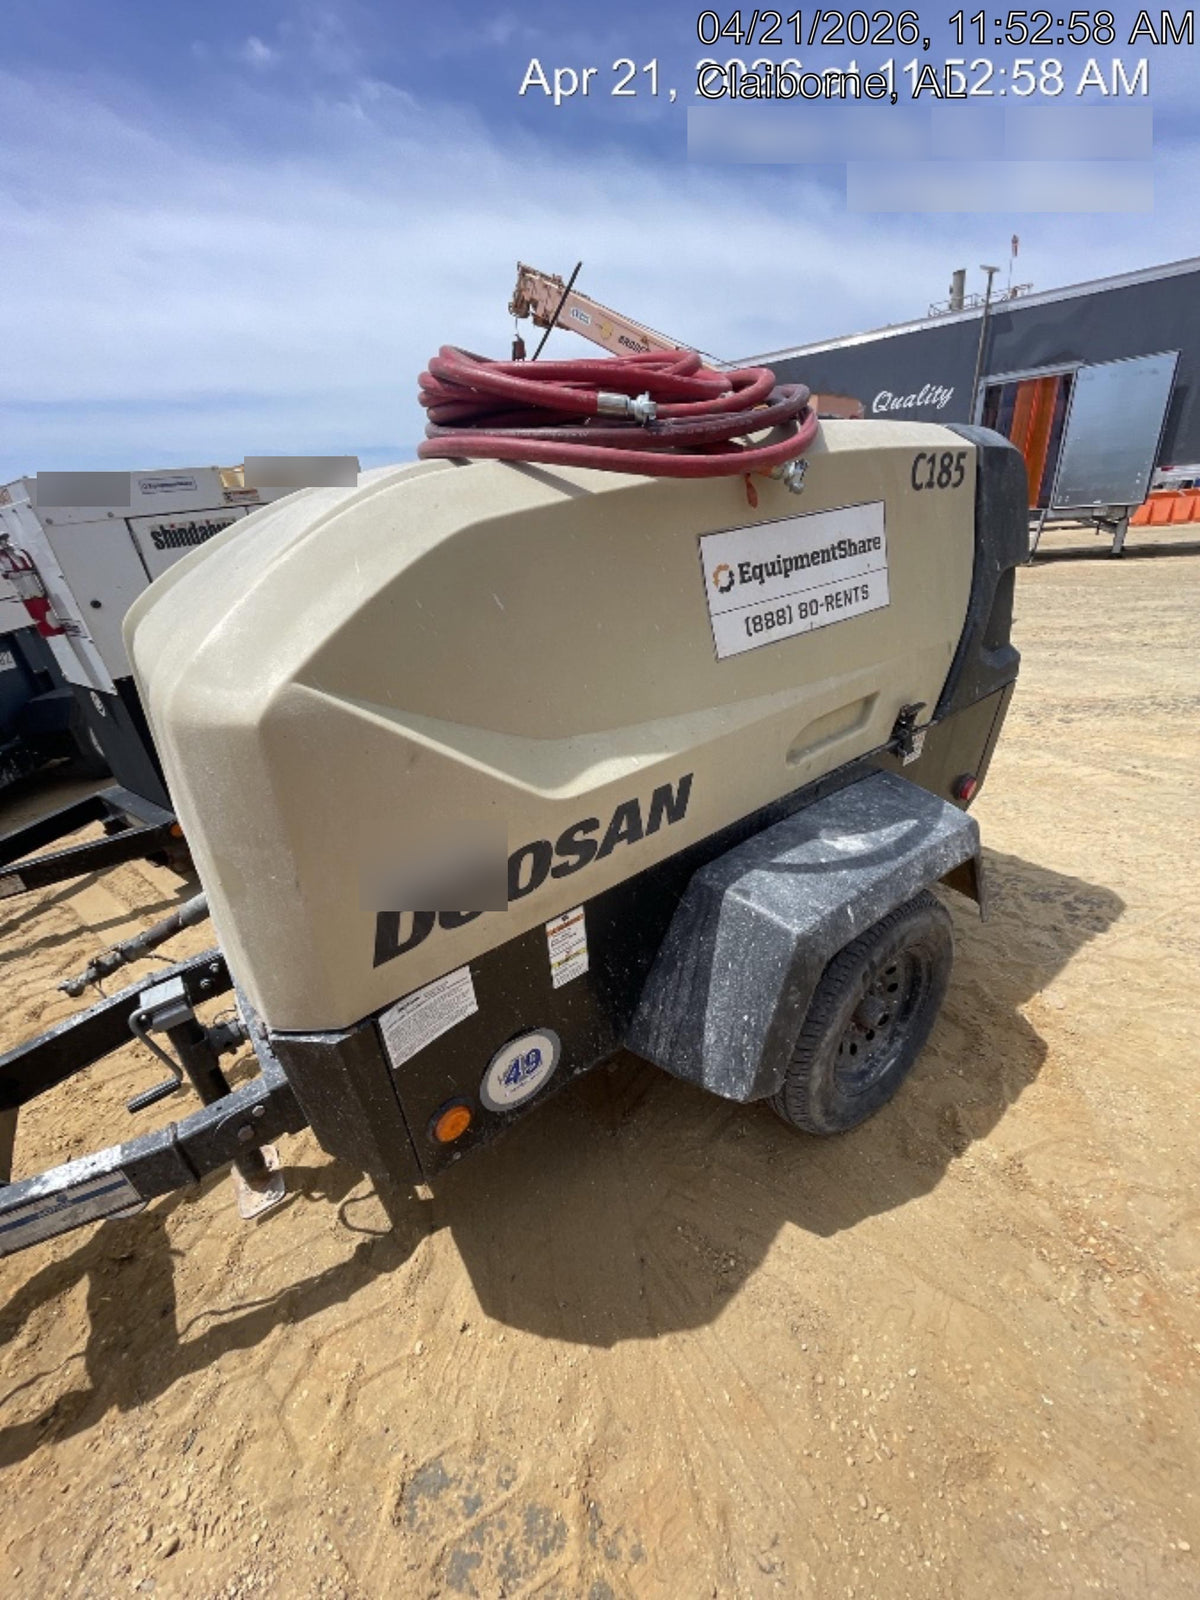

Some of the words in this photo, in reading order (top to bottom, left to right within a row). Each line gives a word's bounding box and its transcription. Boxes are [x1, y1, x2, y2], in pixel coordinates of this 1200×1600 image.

[872, 383, 955, 413] Quality
[911, 451, 968, 491] C185
[738, 536, 881, 585] EquipmentShare
[744, 605, 793, 636] (888)
[798, 584, 869, 620] 80-RENTS
[504, 1047, 542, 1085] 49
